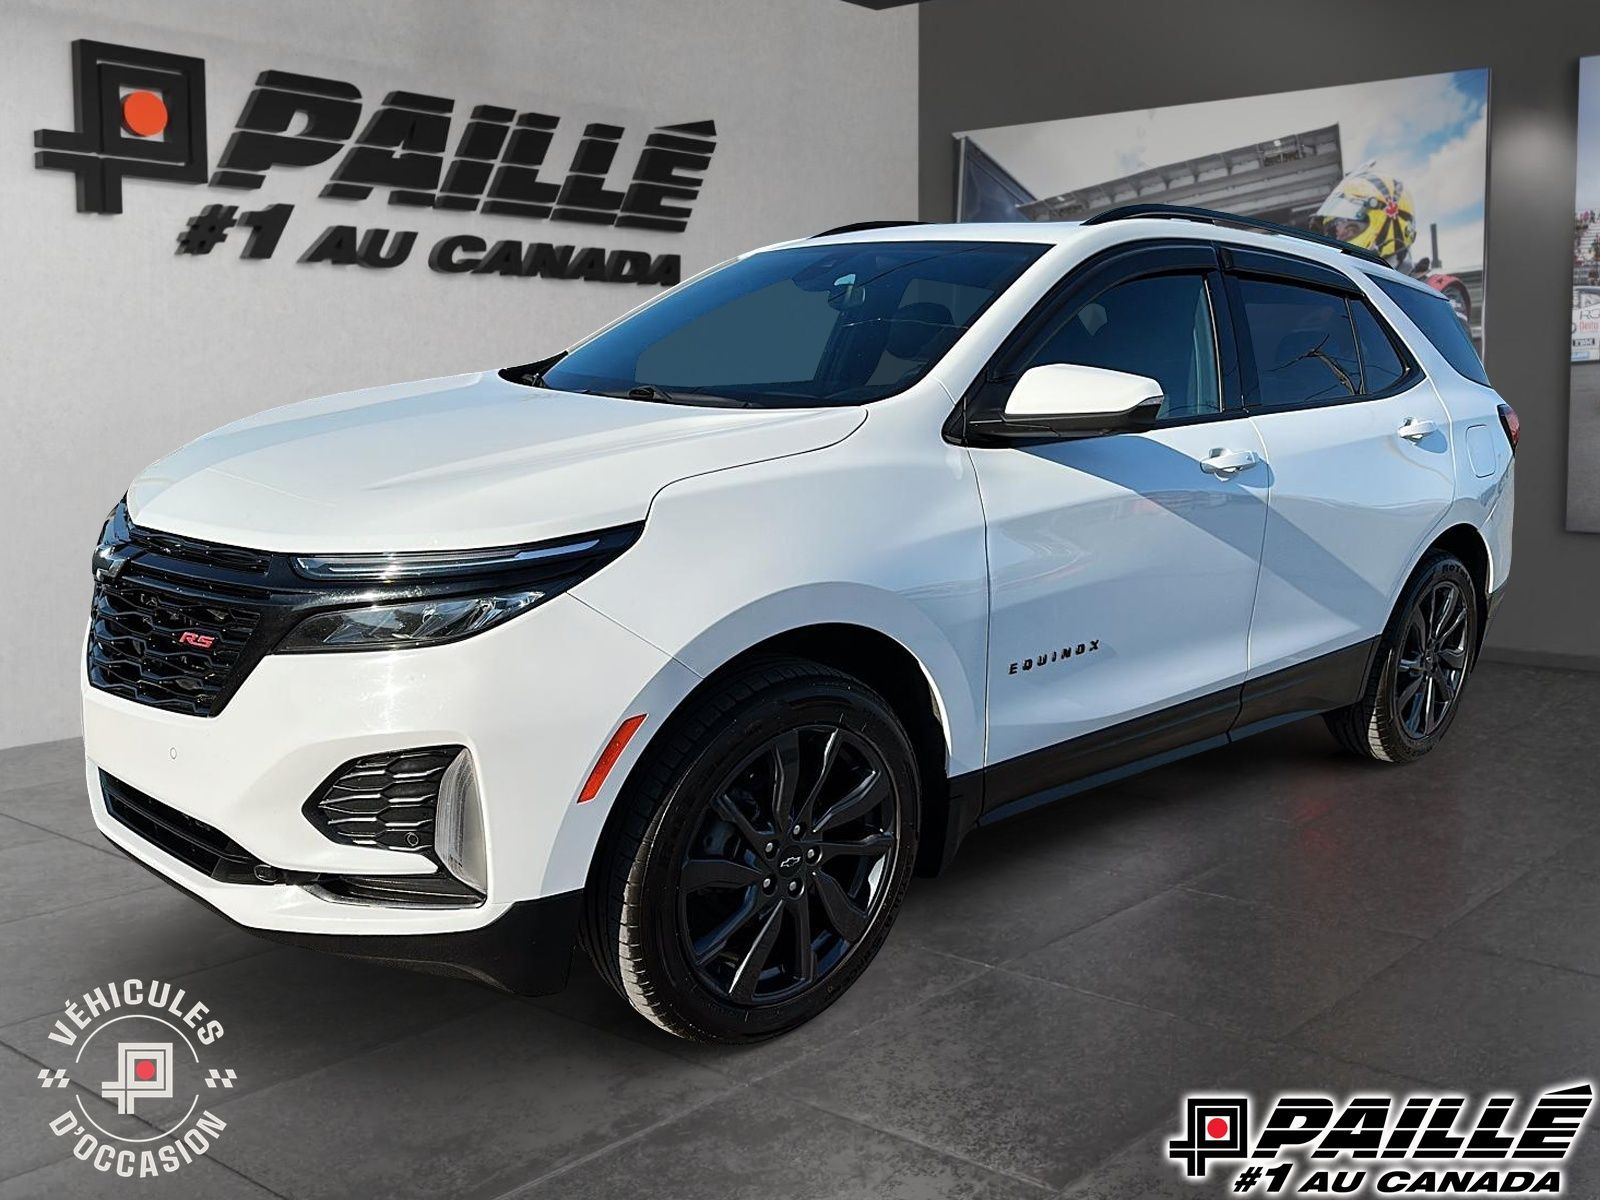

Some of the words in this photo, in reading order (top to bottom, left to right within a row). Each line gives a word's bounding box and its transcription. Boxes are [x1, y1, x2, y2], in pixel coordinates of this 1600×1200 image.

[210, 70, 717, 232] PAILLÉ
[176, 203, 294, 259] #1
[298, 225, 417, 268] AU
[429, 235, 681, 286] CANADA
[180, 632, 215, 648] RS
[1008, 639, 1099, 675] EQUINOX
